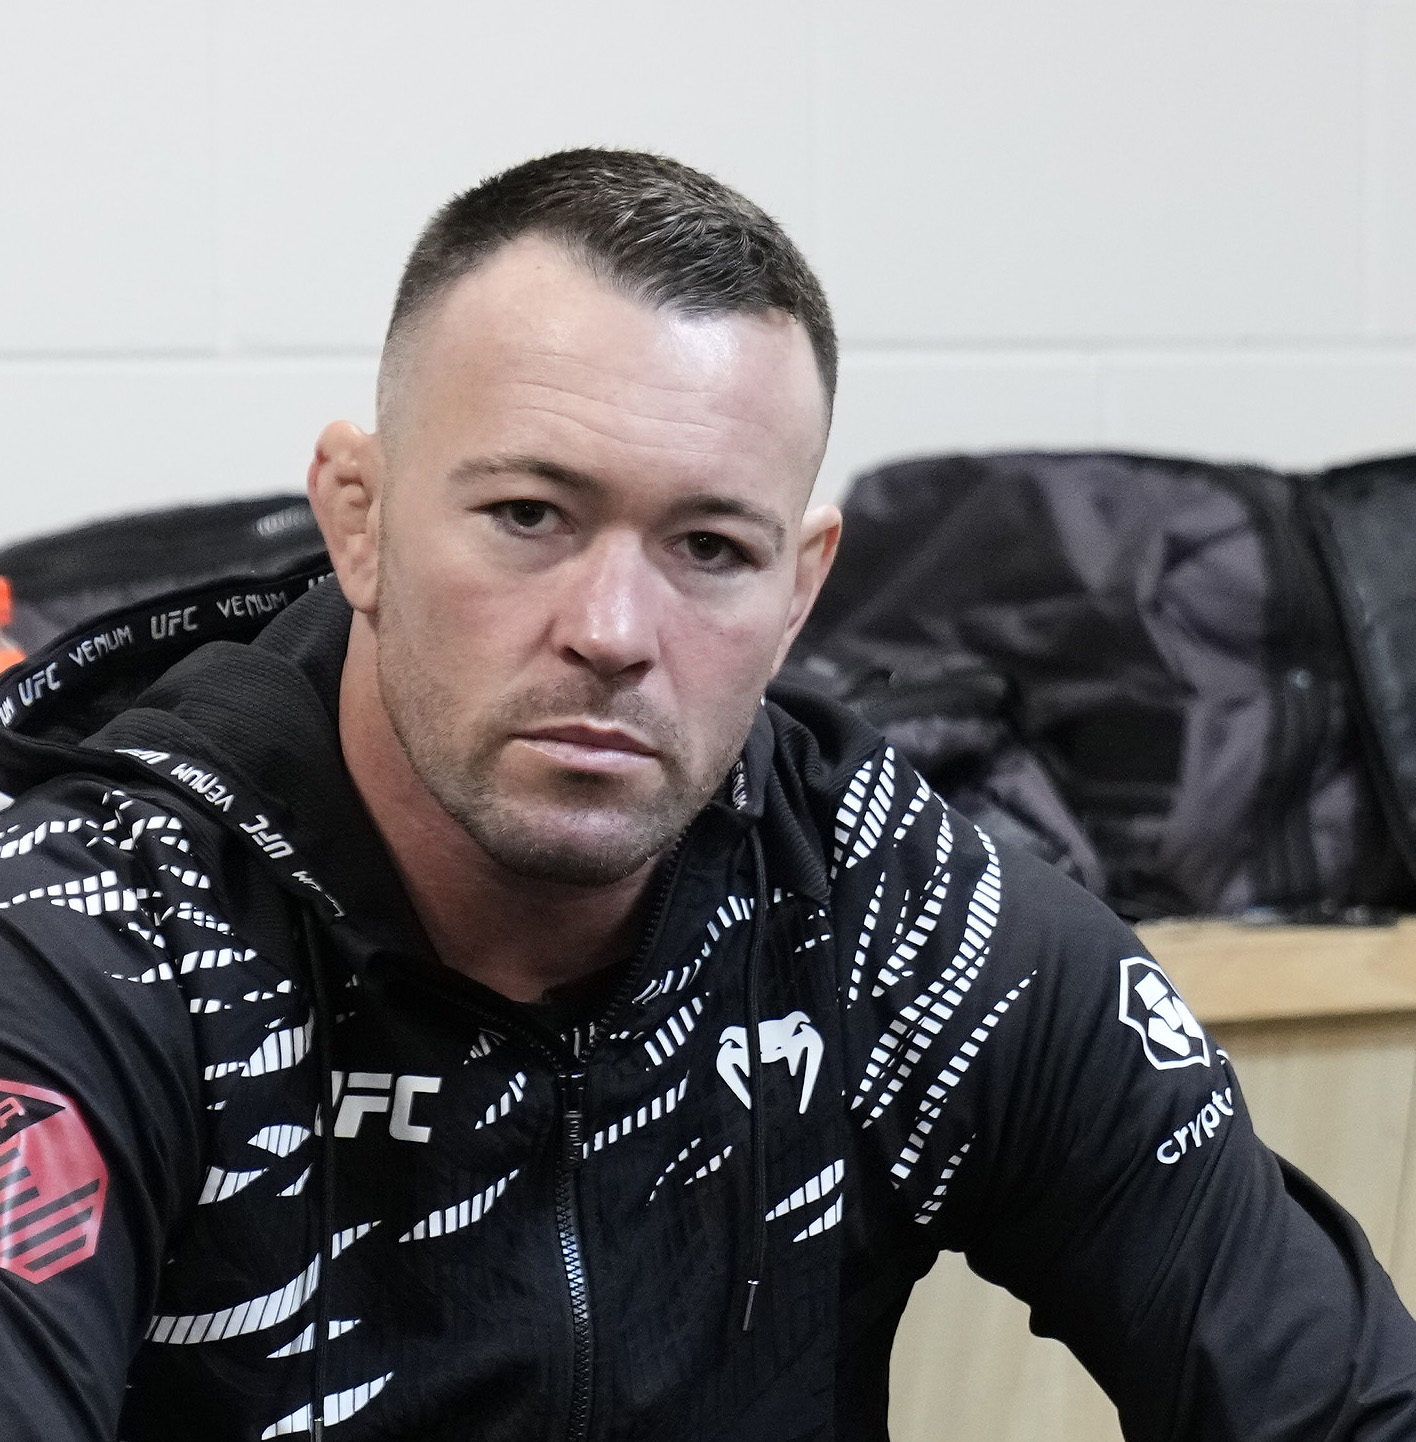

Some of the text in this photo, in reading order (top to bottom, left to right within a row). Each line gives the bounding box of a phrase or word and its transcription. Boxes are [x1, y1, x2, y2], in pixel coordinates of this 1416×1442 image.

[18, 662, 61, 707] UFC
[68, 625, 132, 667] VENUM
[150, 606, 198, 640] UFC
[170, 762, 235, 812] VENUM
[239, 814, 294, 859] UFC
[1156, 1087, 1234, 1165] crypt
